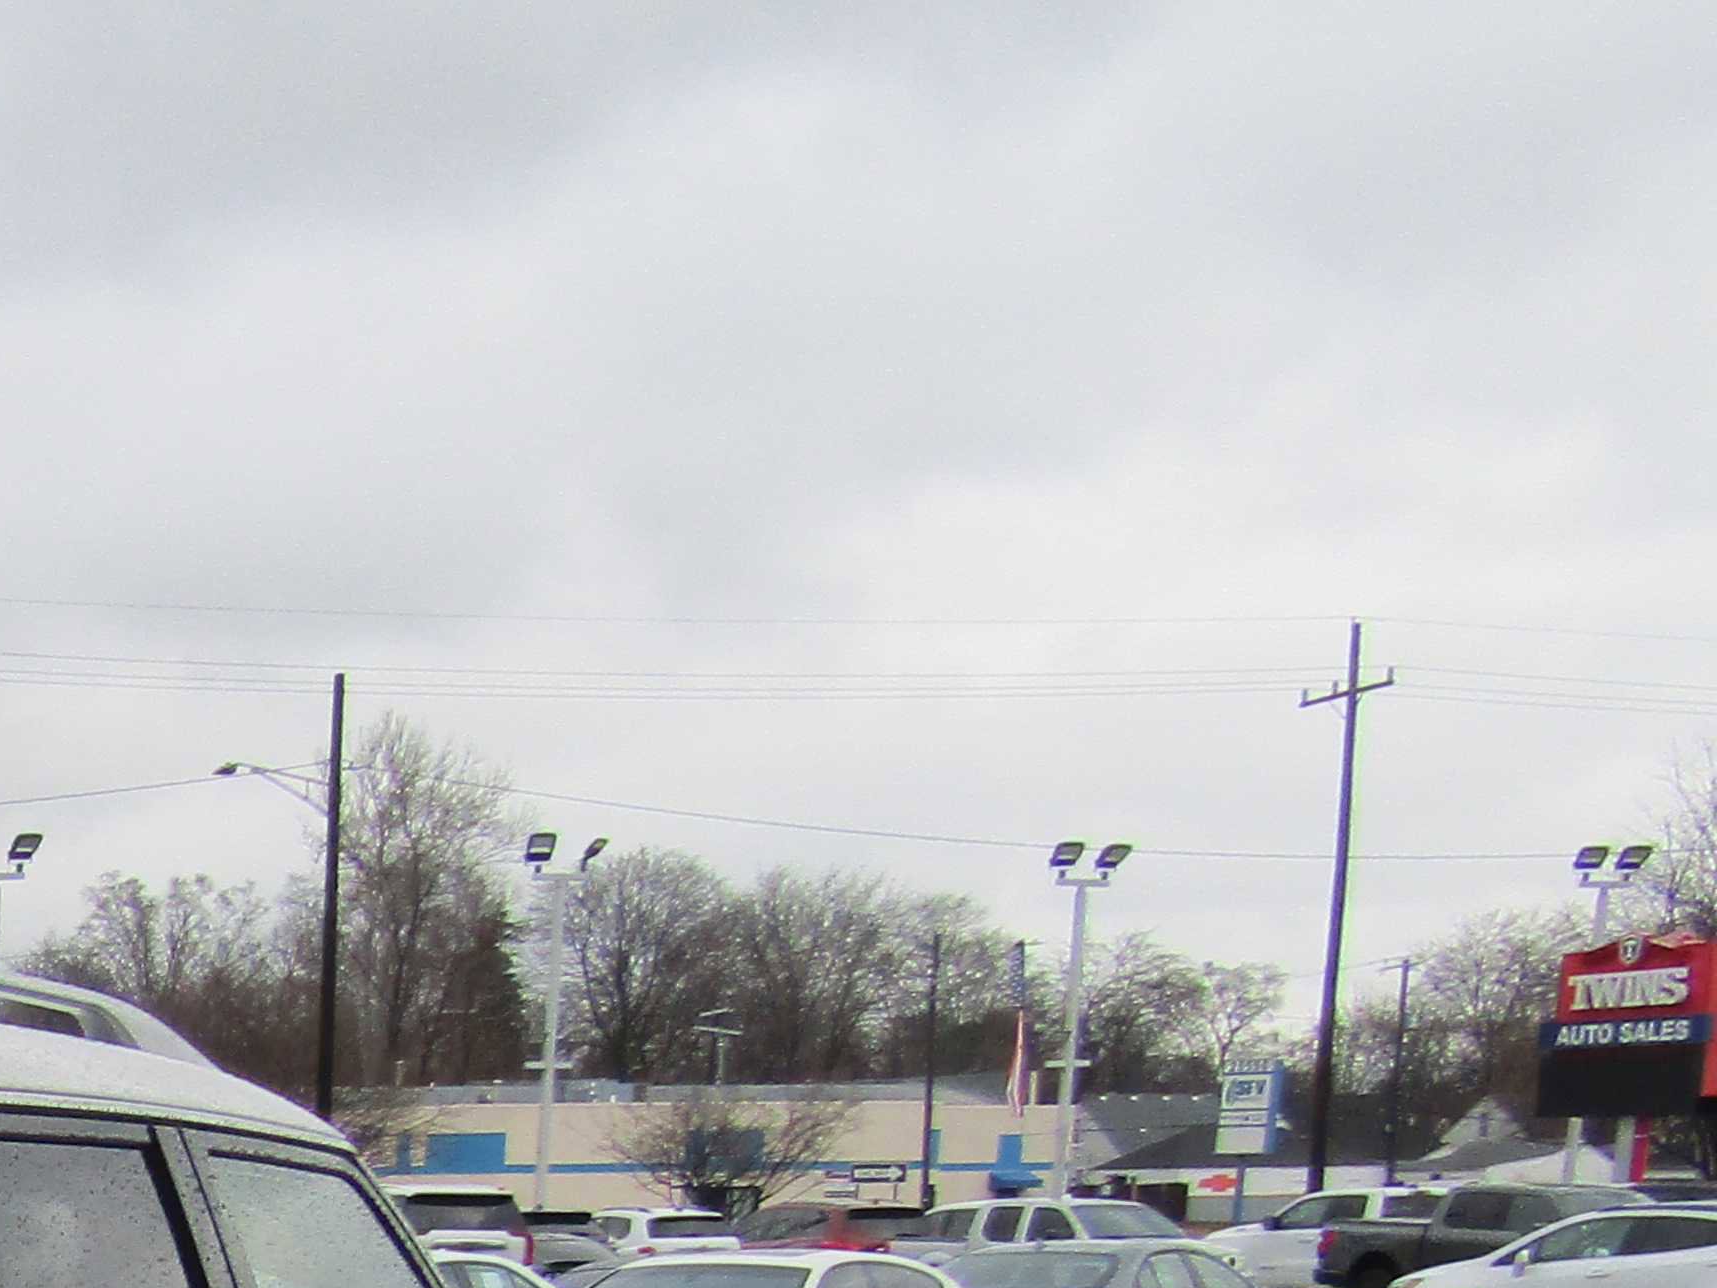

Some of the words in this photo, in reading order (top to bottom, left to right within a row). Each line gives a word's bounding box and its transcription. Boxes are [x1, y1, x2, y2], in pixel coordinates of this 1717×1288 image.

[1568, 967, 1690, 1010] TWINS
[1555, 1024, 1614, 1046] AUTO
[1619, 1019, 1690, 1043] SALES
